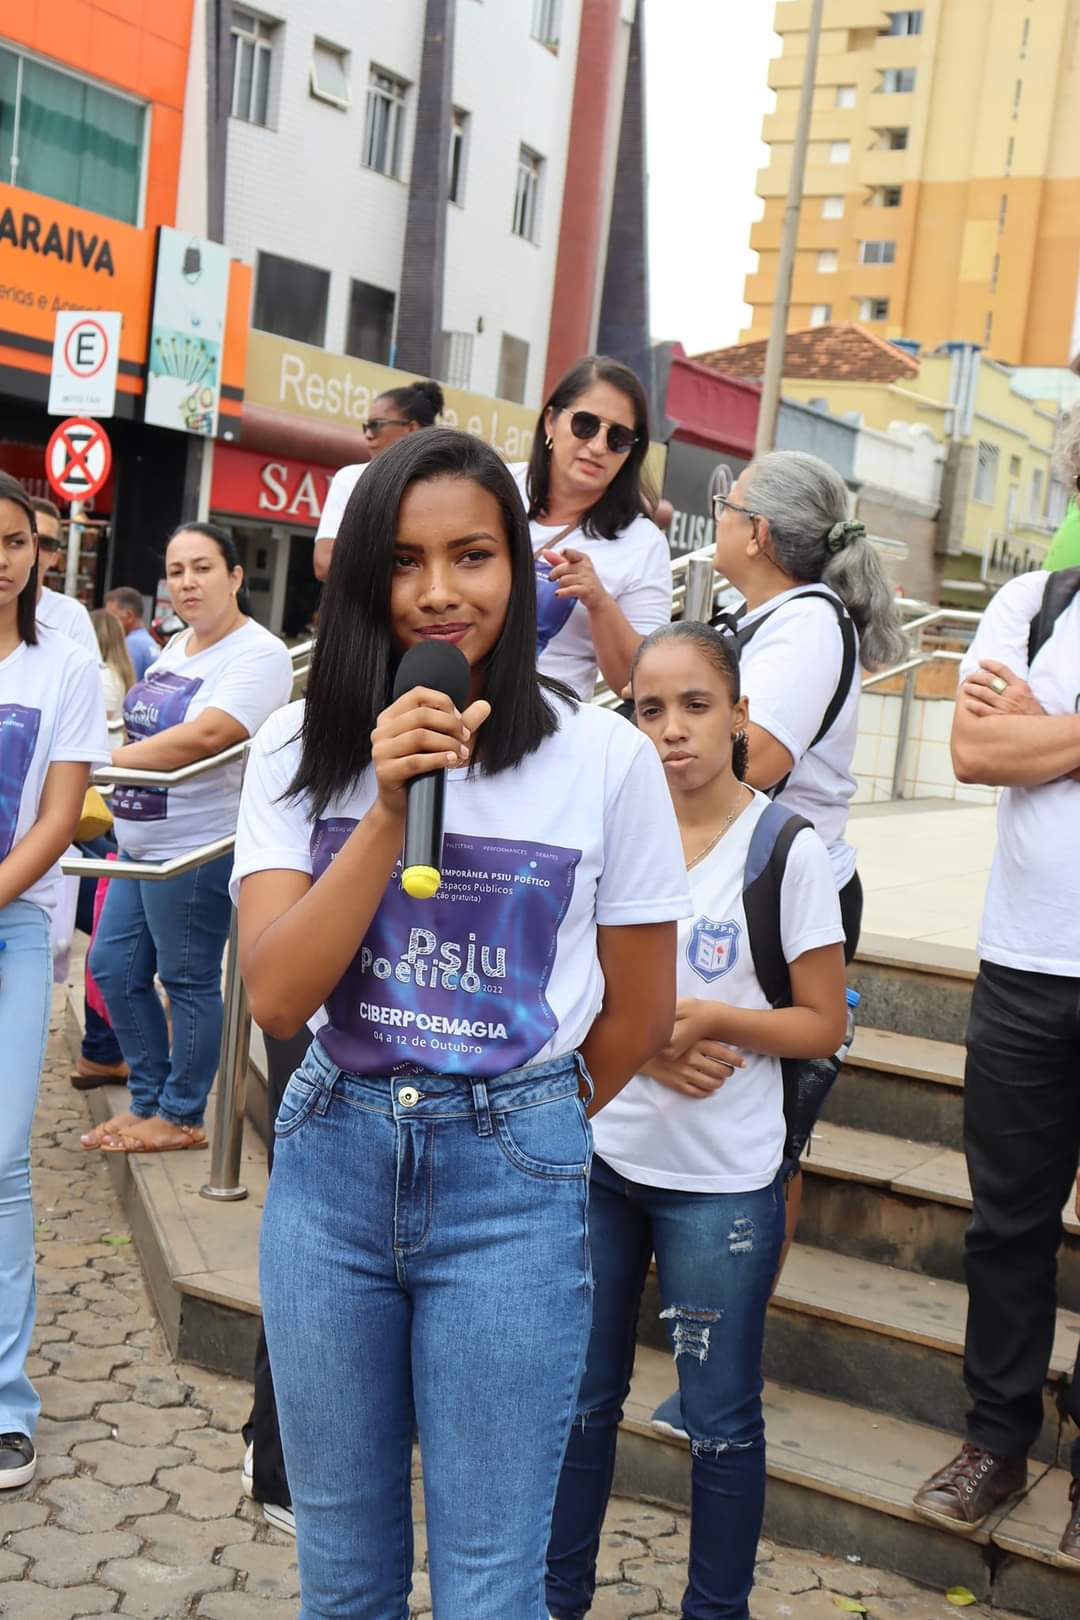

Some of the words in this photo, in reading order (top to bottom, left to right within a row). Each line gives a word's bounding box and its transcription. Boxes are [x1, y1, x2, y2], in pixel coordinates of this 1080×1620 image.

[76, 332, 96, 365] E
[258, 462, 332, 518] SA
[474, 883, 513, 895] Públicos
[491, 872, 512, 882] PSIU
[514, 874, 550, 888] POÉTICO
[360, 946, 481, 993] Poético
[482, 983, 503, 994] 2022
[408, 927, 506, 979] Psiu
[359, 1001, 508, 1040] CIBERPOEMAGIA
[373, 1030, 384, 1042] 04
[386, 1034, 392, 1043] a
[396, 1035, 407, 1045] 12
[411, 1036, 427, 1047] de
[430, 1037, 482, 1055] Outubro
